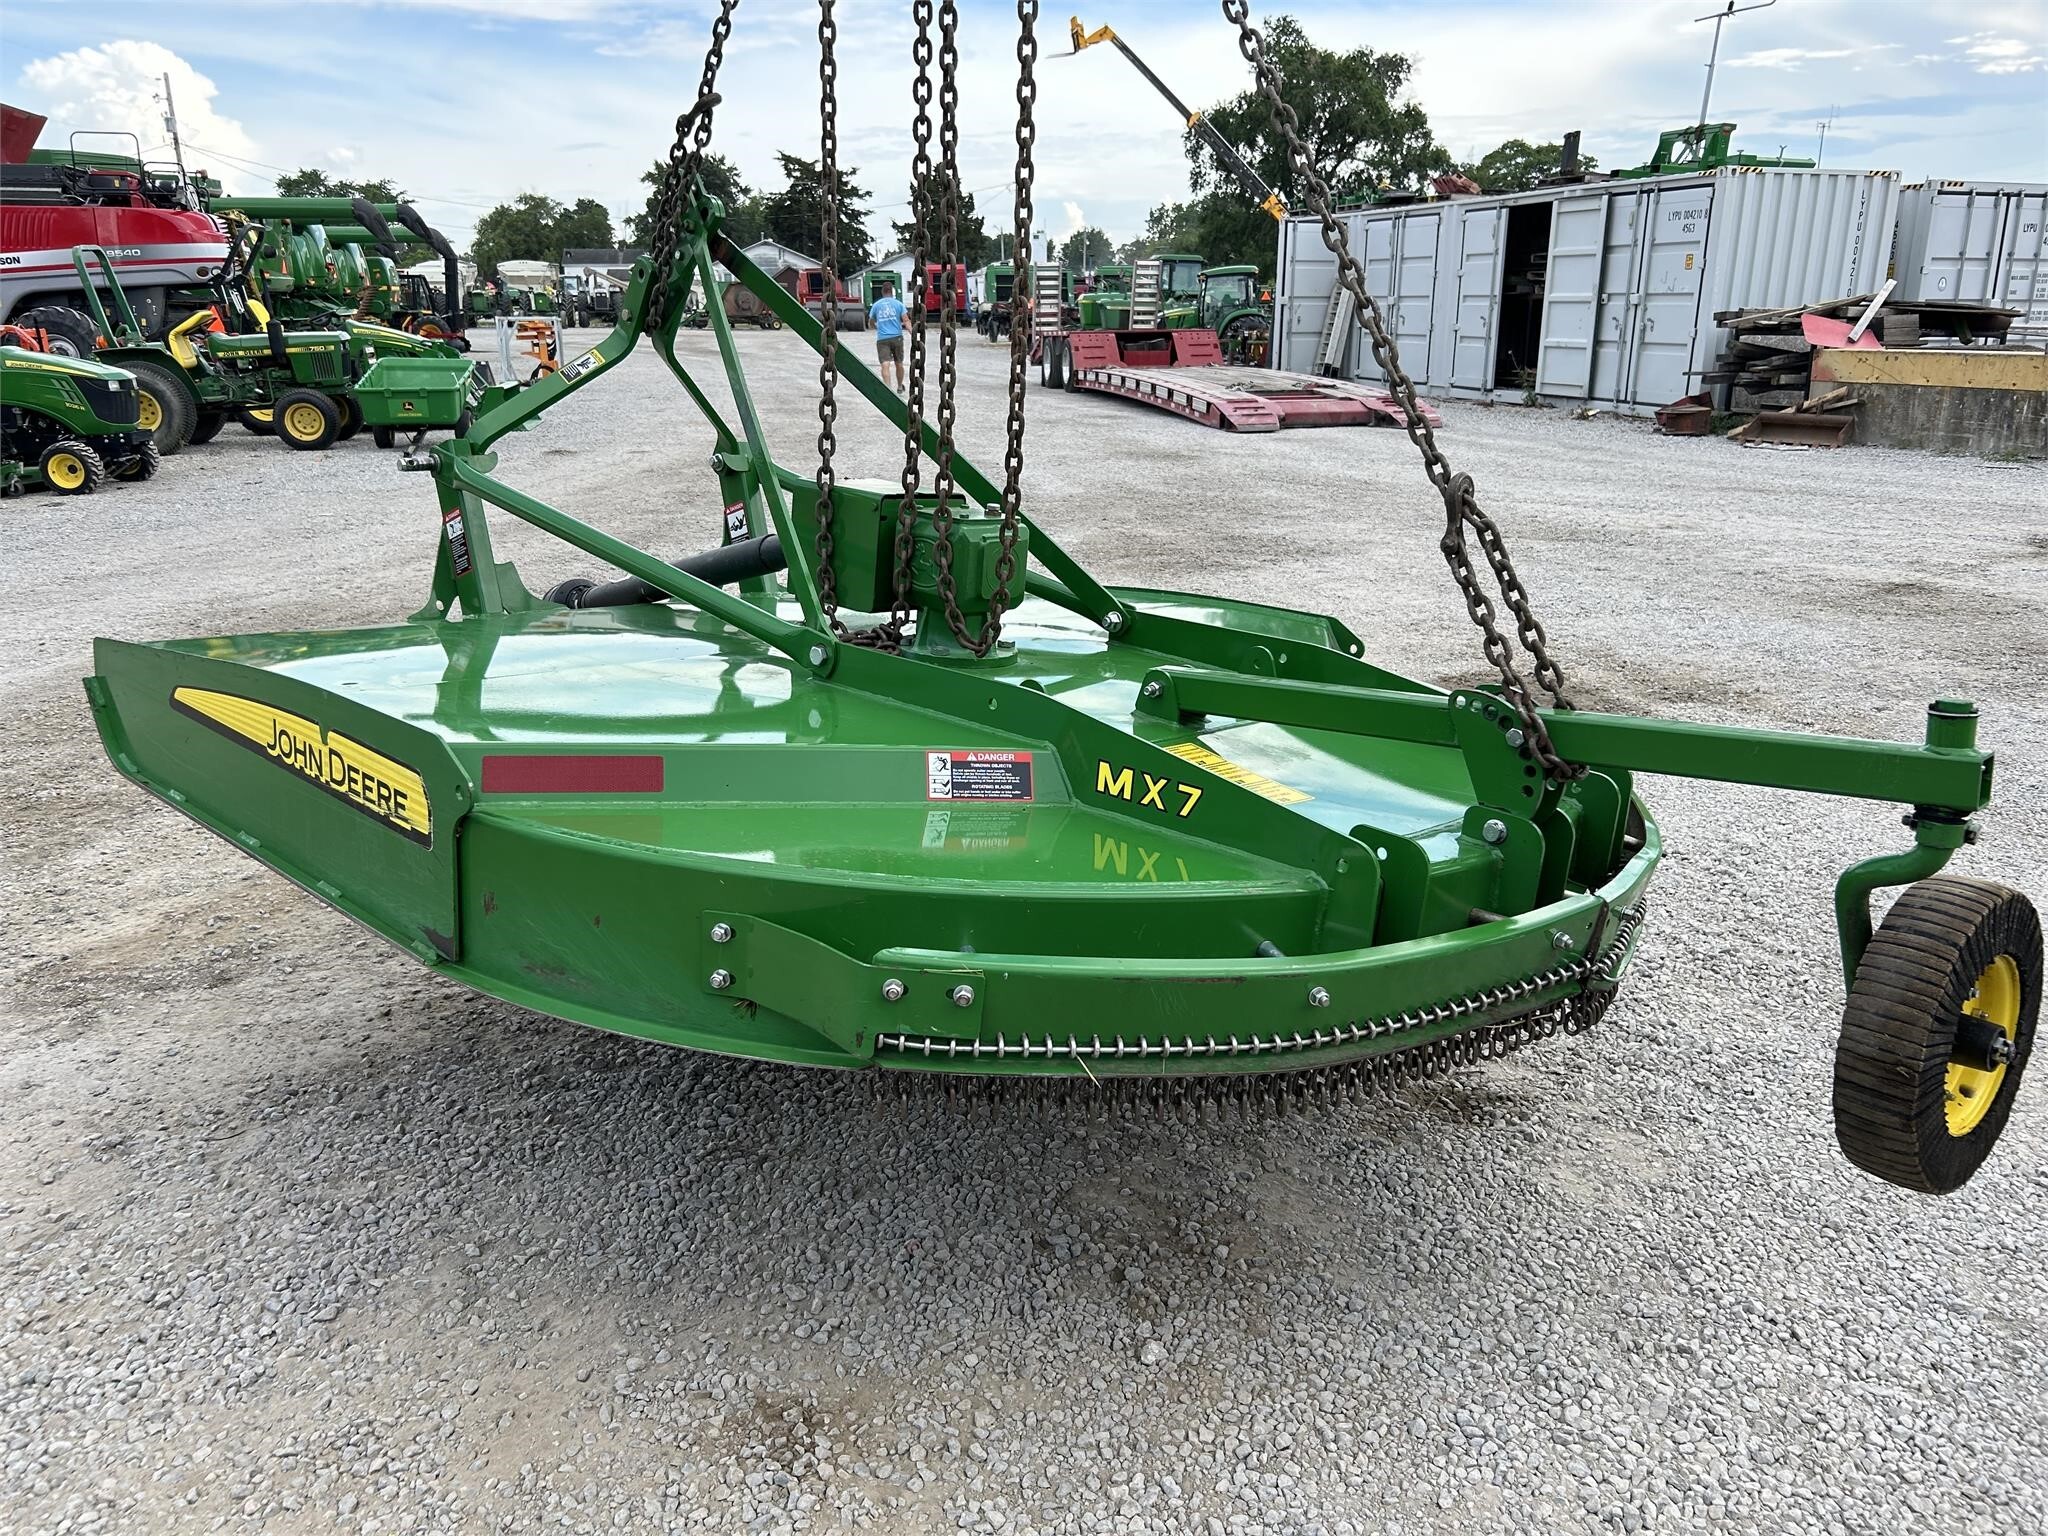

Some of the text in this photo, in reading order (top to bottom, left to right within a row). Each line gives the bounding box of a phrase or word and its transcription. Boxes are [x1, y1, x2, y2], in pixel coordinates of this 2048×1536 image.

[1668, 211, 1682, 221] LYPU
[1683, 209, 1703, 220] 004210
[1857, 189, 1866, 232] LYPU
[2023, 223, 2037, 233] LYPU
[106, 249, 141, 258] 9540
[1846, 235, 1860, 298] 004210
[977, 753, 1015, 761] DANGER
[266, 718, 413, 824] JOHN DEERE
[1095, 759, 1204, 818] MX7
